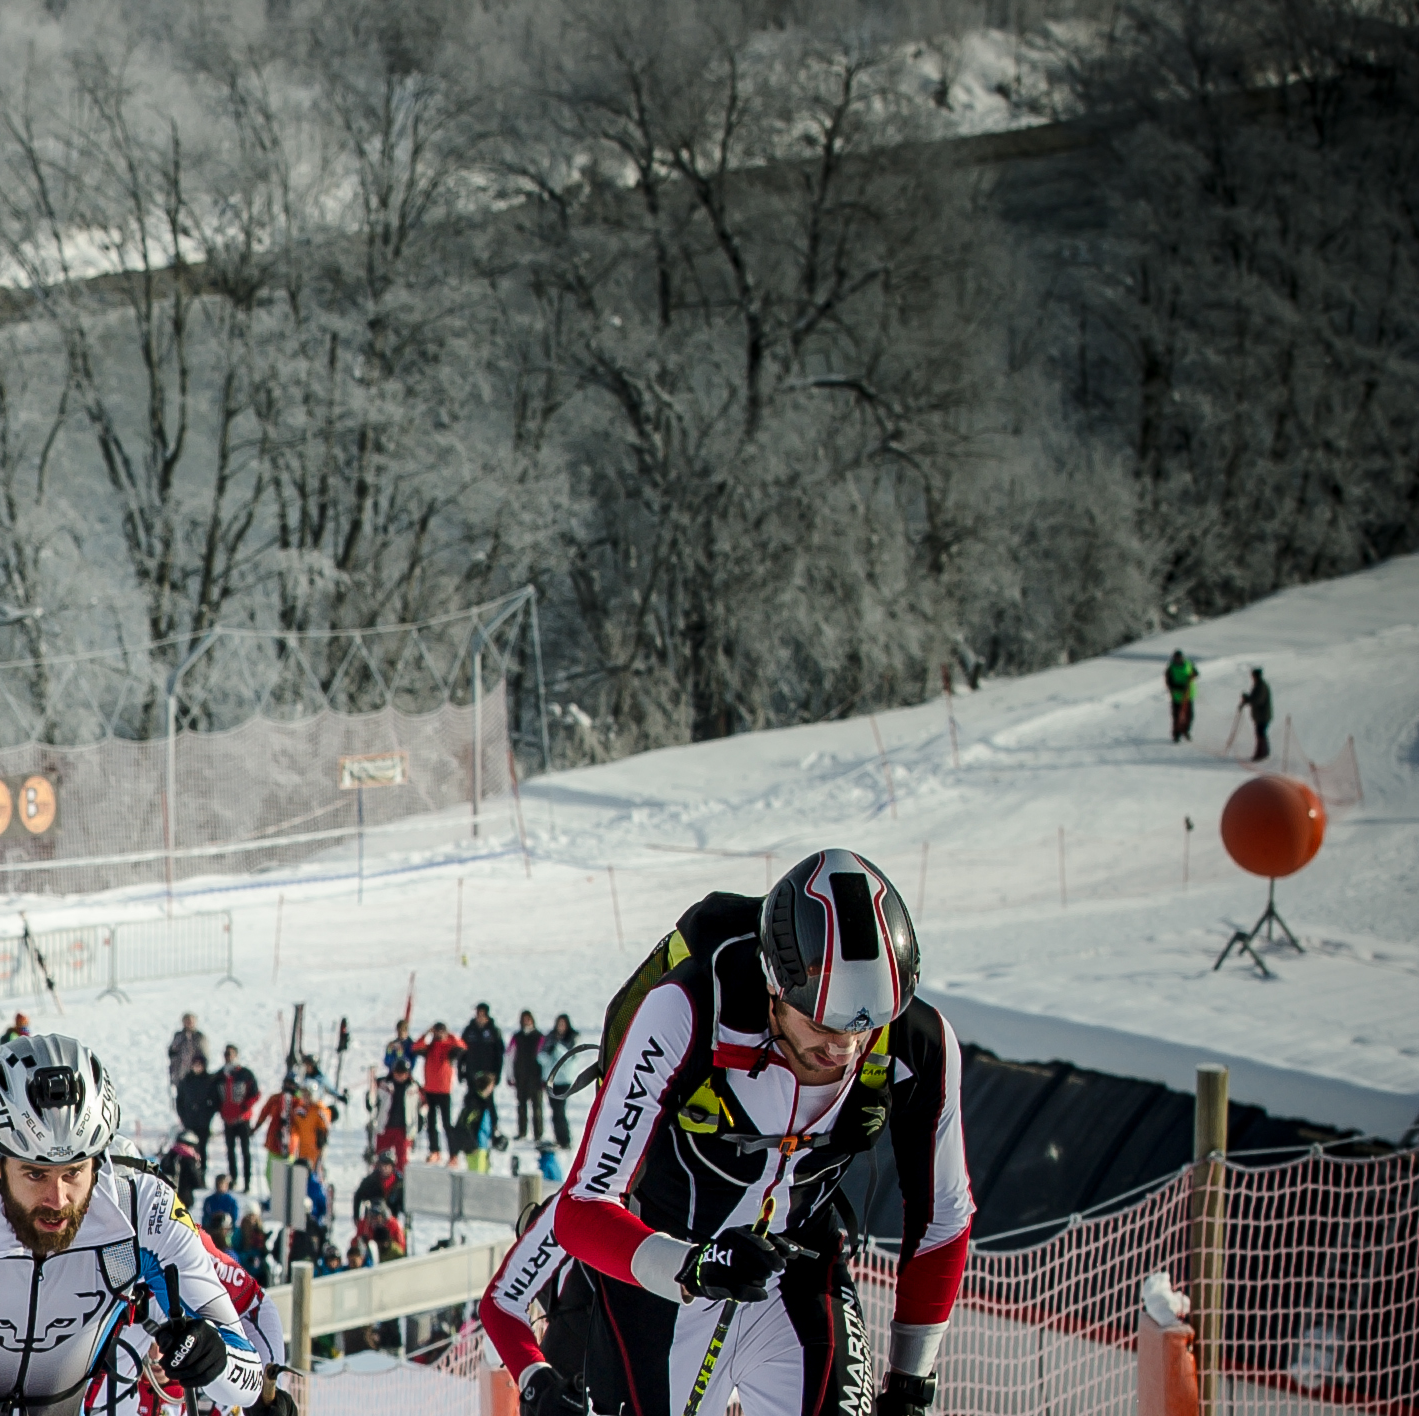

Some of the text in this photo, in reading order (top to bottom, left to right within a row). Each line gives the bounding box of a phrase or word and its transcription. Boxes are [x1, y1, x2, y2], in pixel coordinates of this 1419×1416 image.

[22, 1111, 46, 1142] PELE
[585, 1036, 665, 1195] MARTINI
[170, 1334, 196, 1368] adidas
[694, 1337, 723, 1394] LEKI
